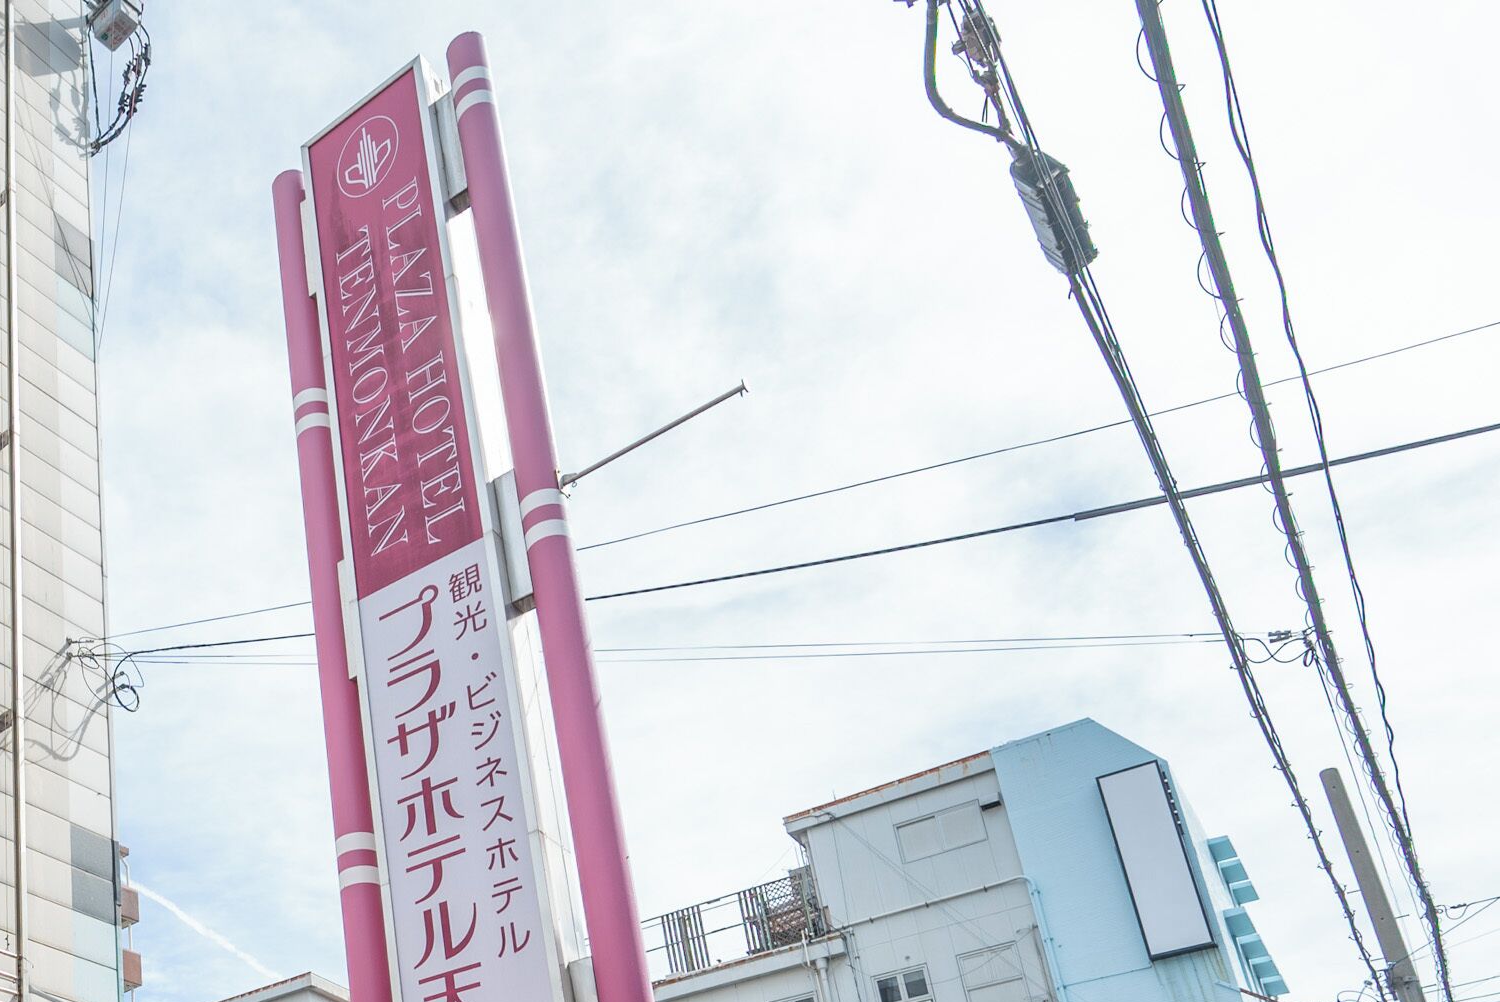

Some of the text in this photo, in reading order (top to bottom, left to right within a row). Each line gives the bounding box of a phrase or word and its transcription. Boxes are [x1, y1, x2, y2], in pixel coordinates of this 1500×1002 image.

[335, 225, 408, 557] TENMONKAN
[381, 176, 466, 544] PLAZA HOTEL
[448, 562, 530, 958] 観光・ビジネスホテル
